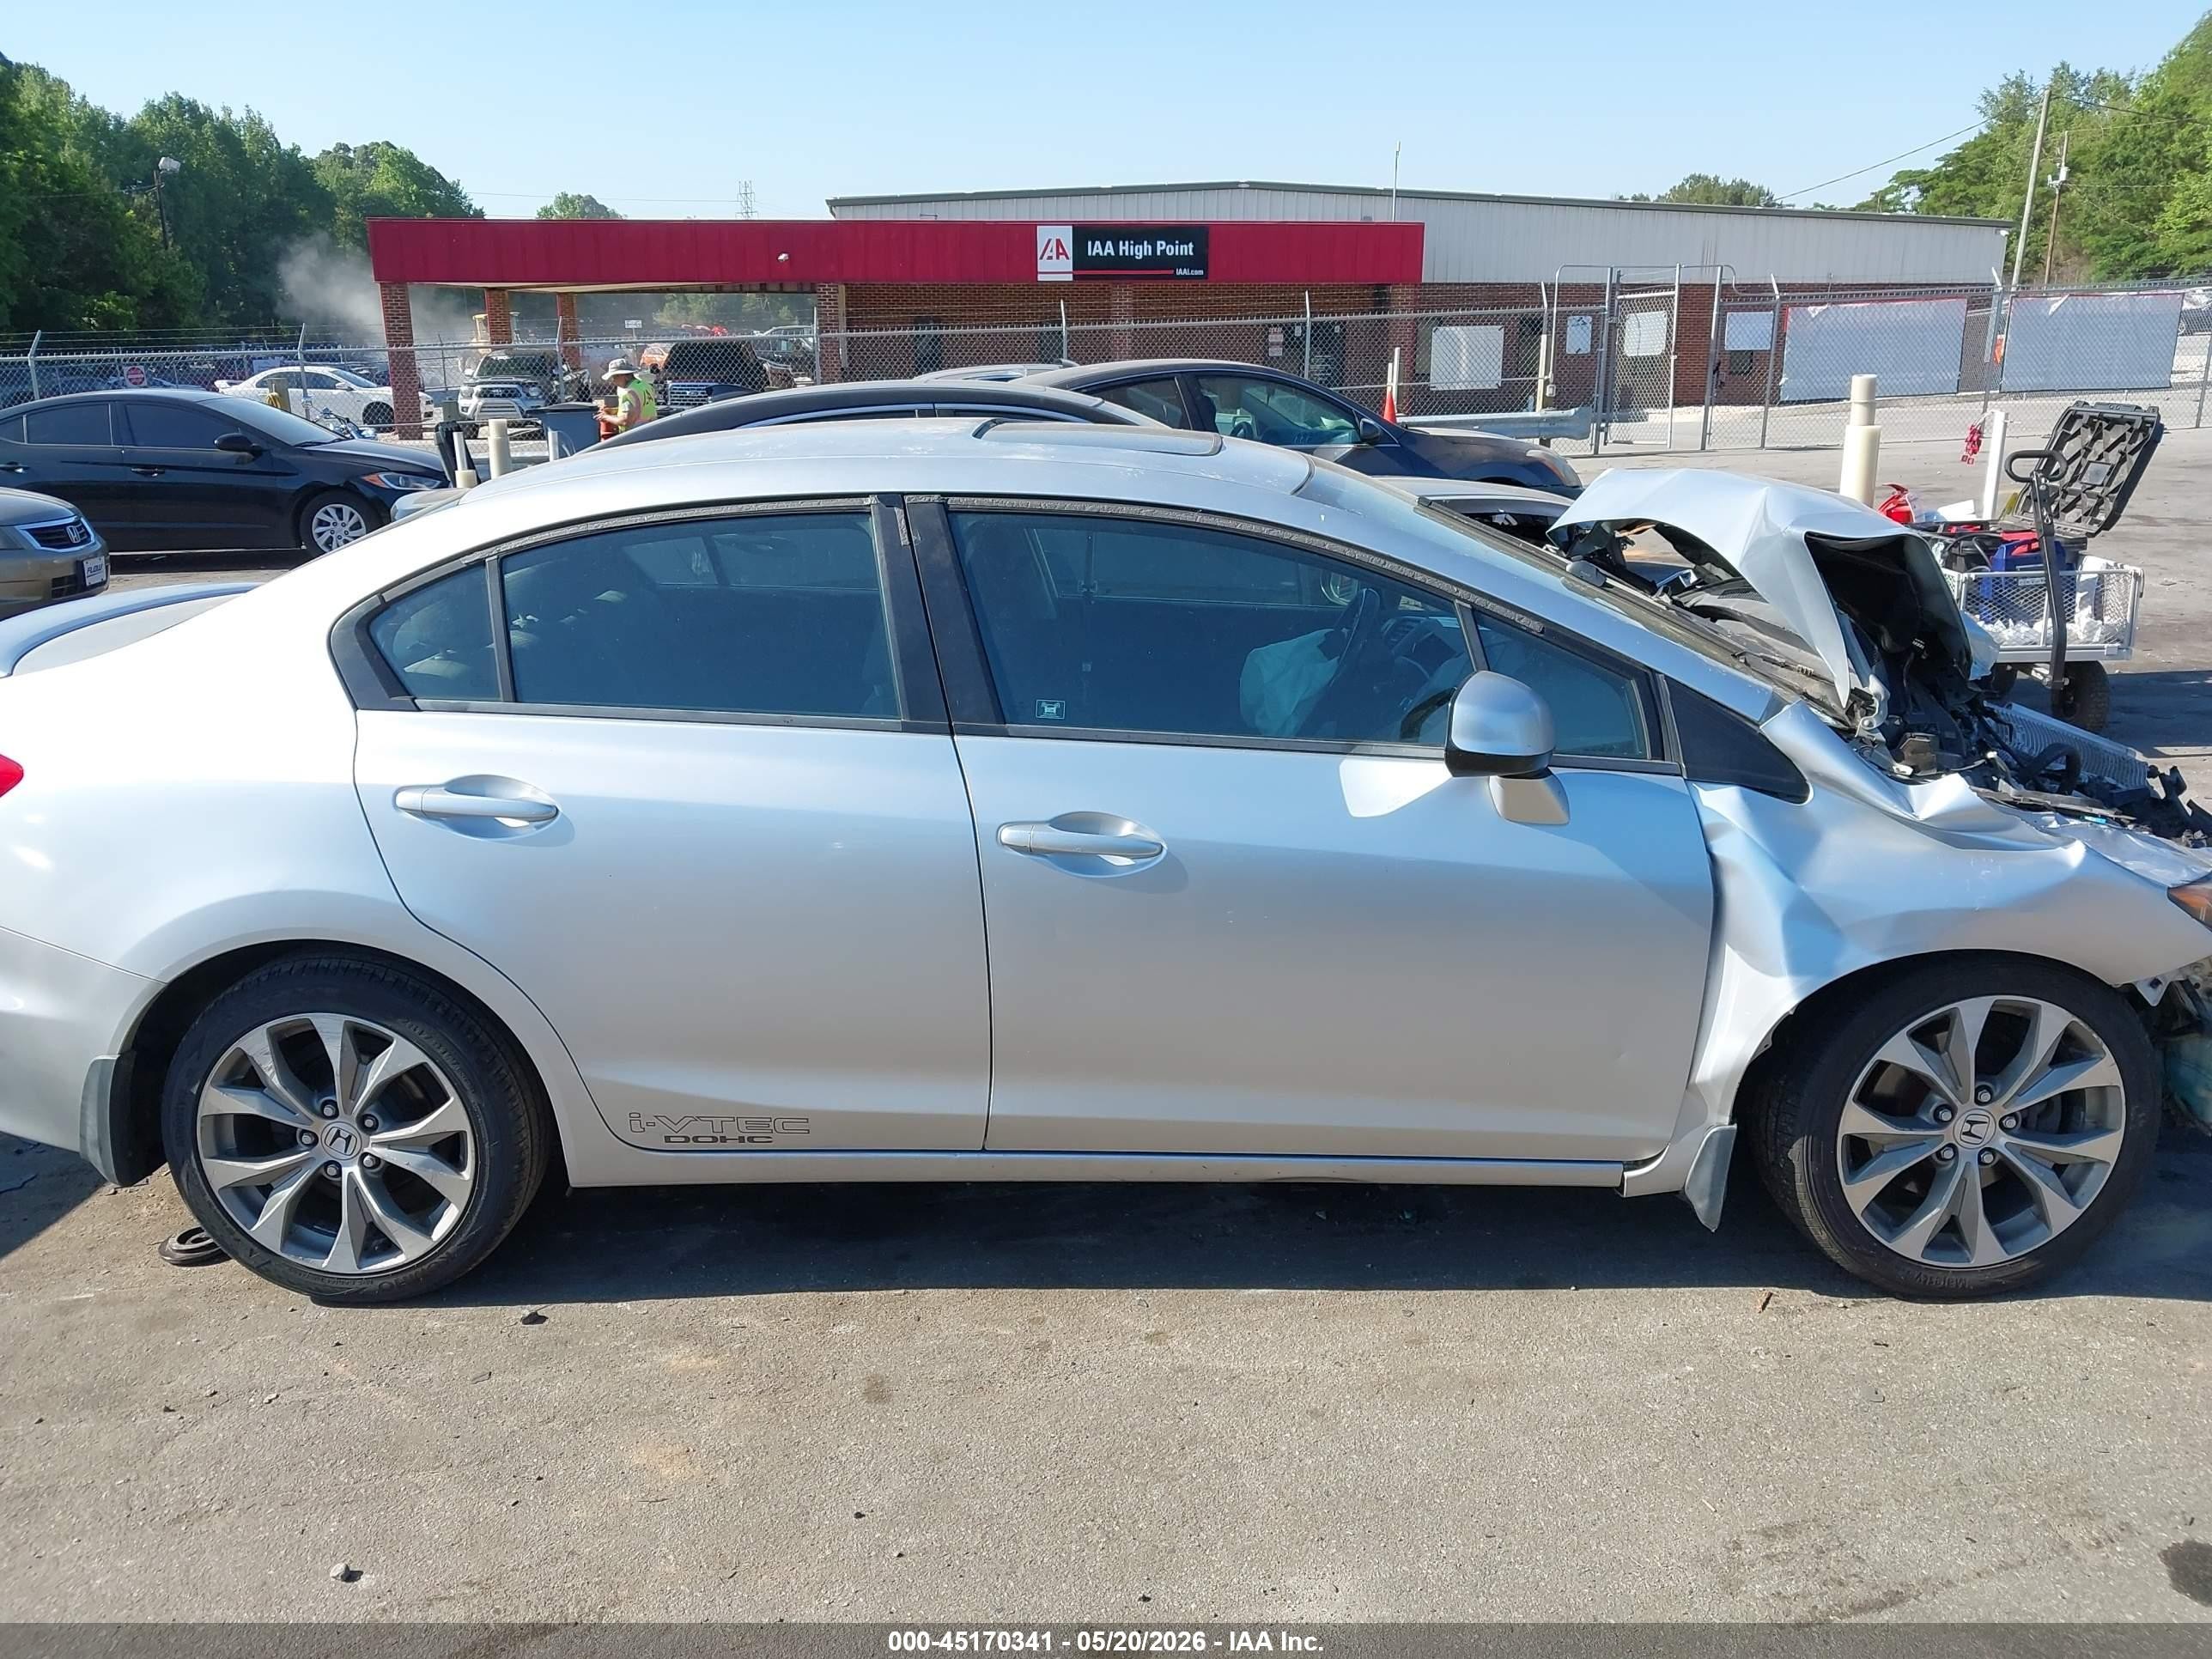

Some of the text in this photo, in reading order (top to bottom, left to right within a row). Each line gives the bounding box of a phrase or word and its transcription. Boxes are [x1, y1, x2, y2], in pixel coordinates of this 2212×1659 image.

[1087, 240, 1194, 260] IAA High Point
[629, 1112, 810, 1134] i-VTEC
[664, 1135, 774, 1144] DOHC
